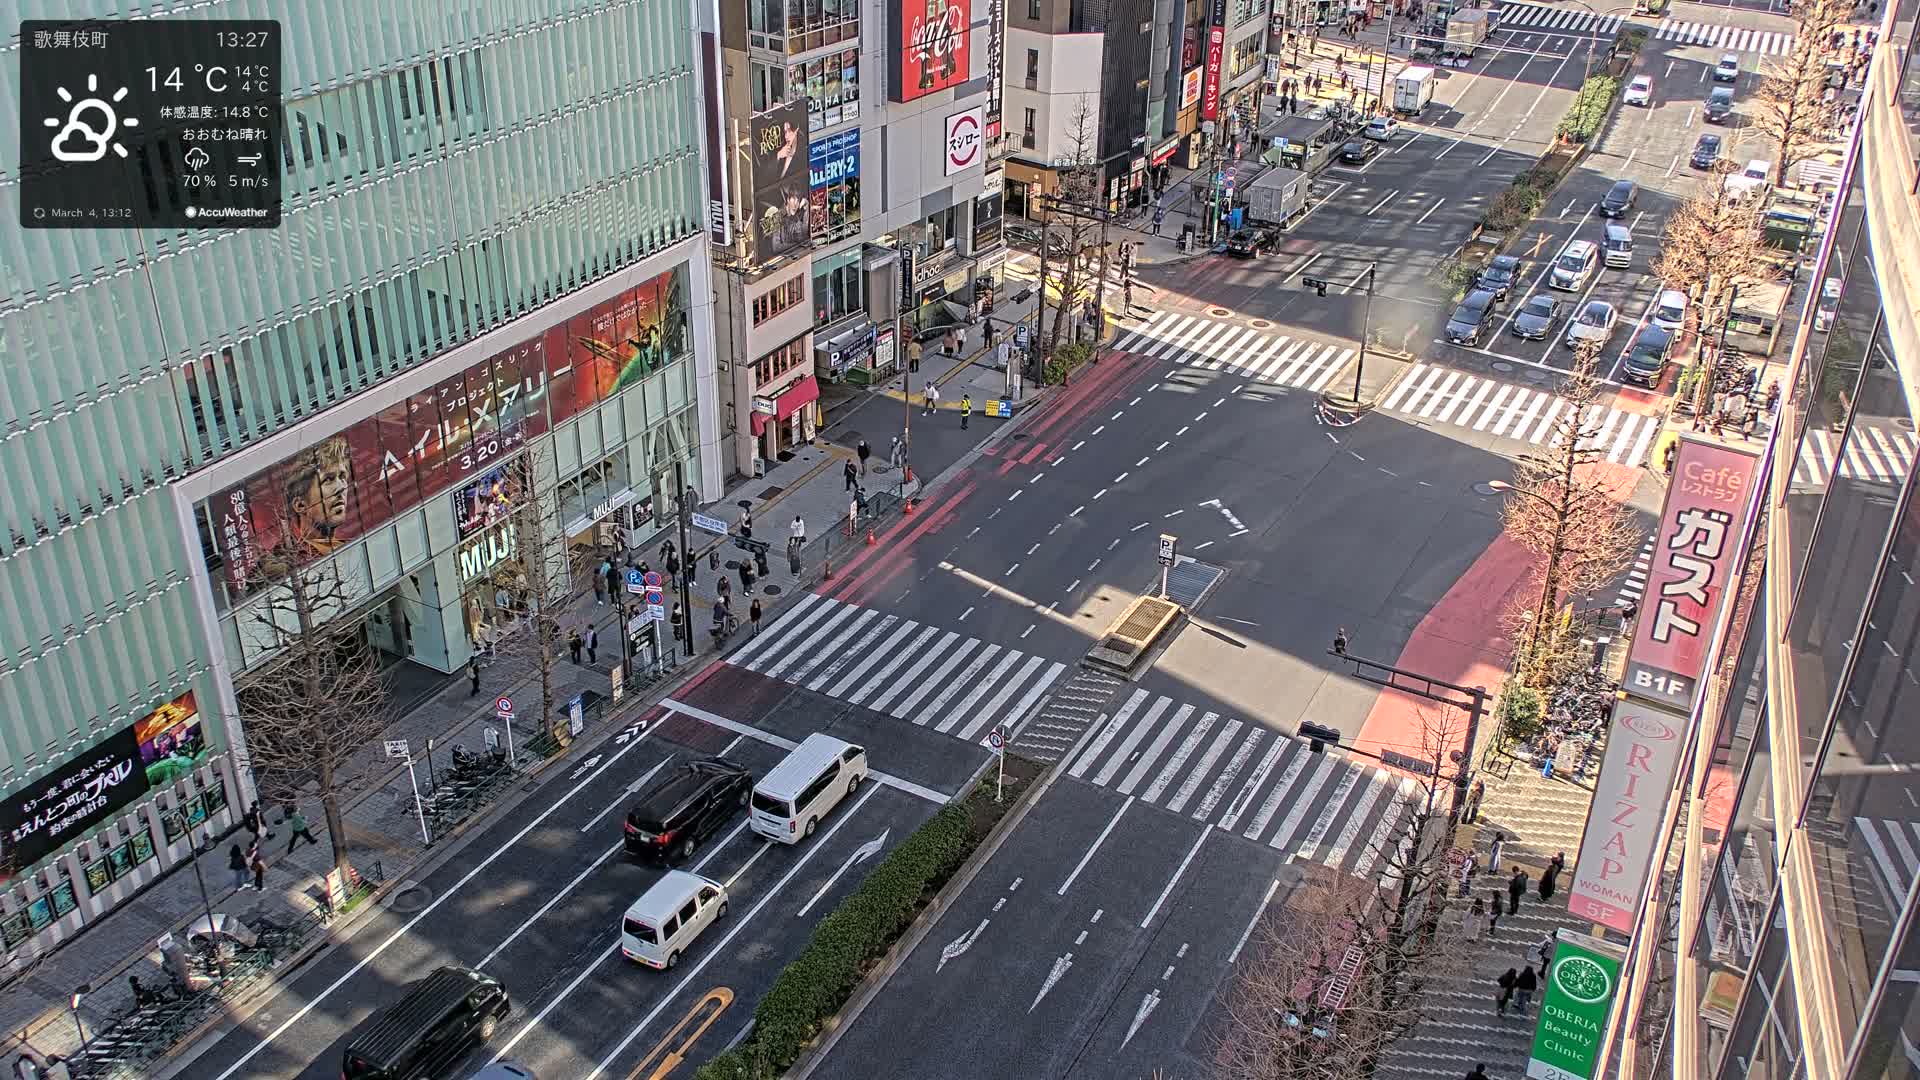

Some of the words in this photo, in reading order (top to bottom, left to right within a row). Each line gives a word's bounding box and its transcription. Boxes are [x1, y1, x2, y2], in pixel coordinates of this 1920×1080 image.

[910, 5, 963, 64] Coca-Cola
[1207, 46, 1220, 110] バーガーキング
[826, 88, 855, 108] HALL
[948, 133, 980, 152] スシロー
[711, 200, 723, 232] MUJI
[903, 250, 912, 259] P
[1018, 327, 1026, 335] P
[831, 352, 839, 366] P
[411, 342, 541, 413] ライアン・ゴズリング
[447, 377, 504, 412] プロジェクト
[758, 401, 772, 409] DUG
[378, 360, 574, 483] ヘイル・メアリー
[1685, 461, 1741, 490] Café
[1681, 479, 1737, 502] レストラン
[593, 497, 615, 520] MUJI
[460, 523, 516, 581] MUJI
[1161, 540, 1169, 549] P
[1650, 508, 1733, 643] ガスト
[1634, 669, 1686, 697] B1F
[20, 758, 132, 838] えんとつ町のプペル
[1599, 743, 1655, 880] RIZAP
[1580, 880, 1632, 904] WOMAN
[1586, 902, 1615, 919] 5F
[1561, 970, 1601, 991] OBERIA
[1544, 1005, 1599, 1032] OBERIA
[1544, 1020, 1592, 1046] Beauty
[1543, 1039, 1585, 1062] Clinic
